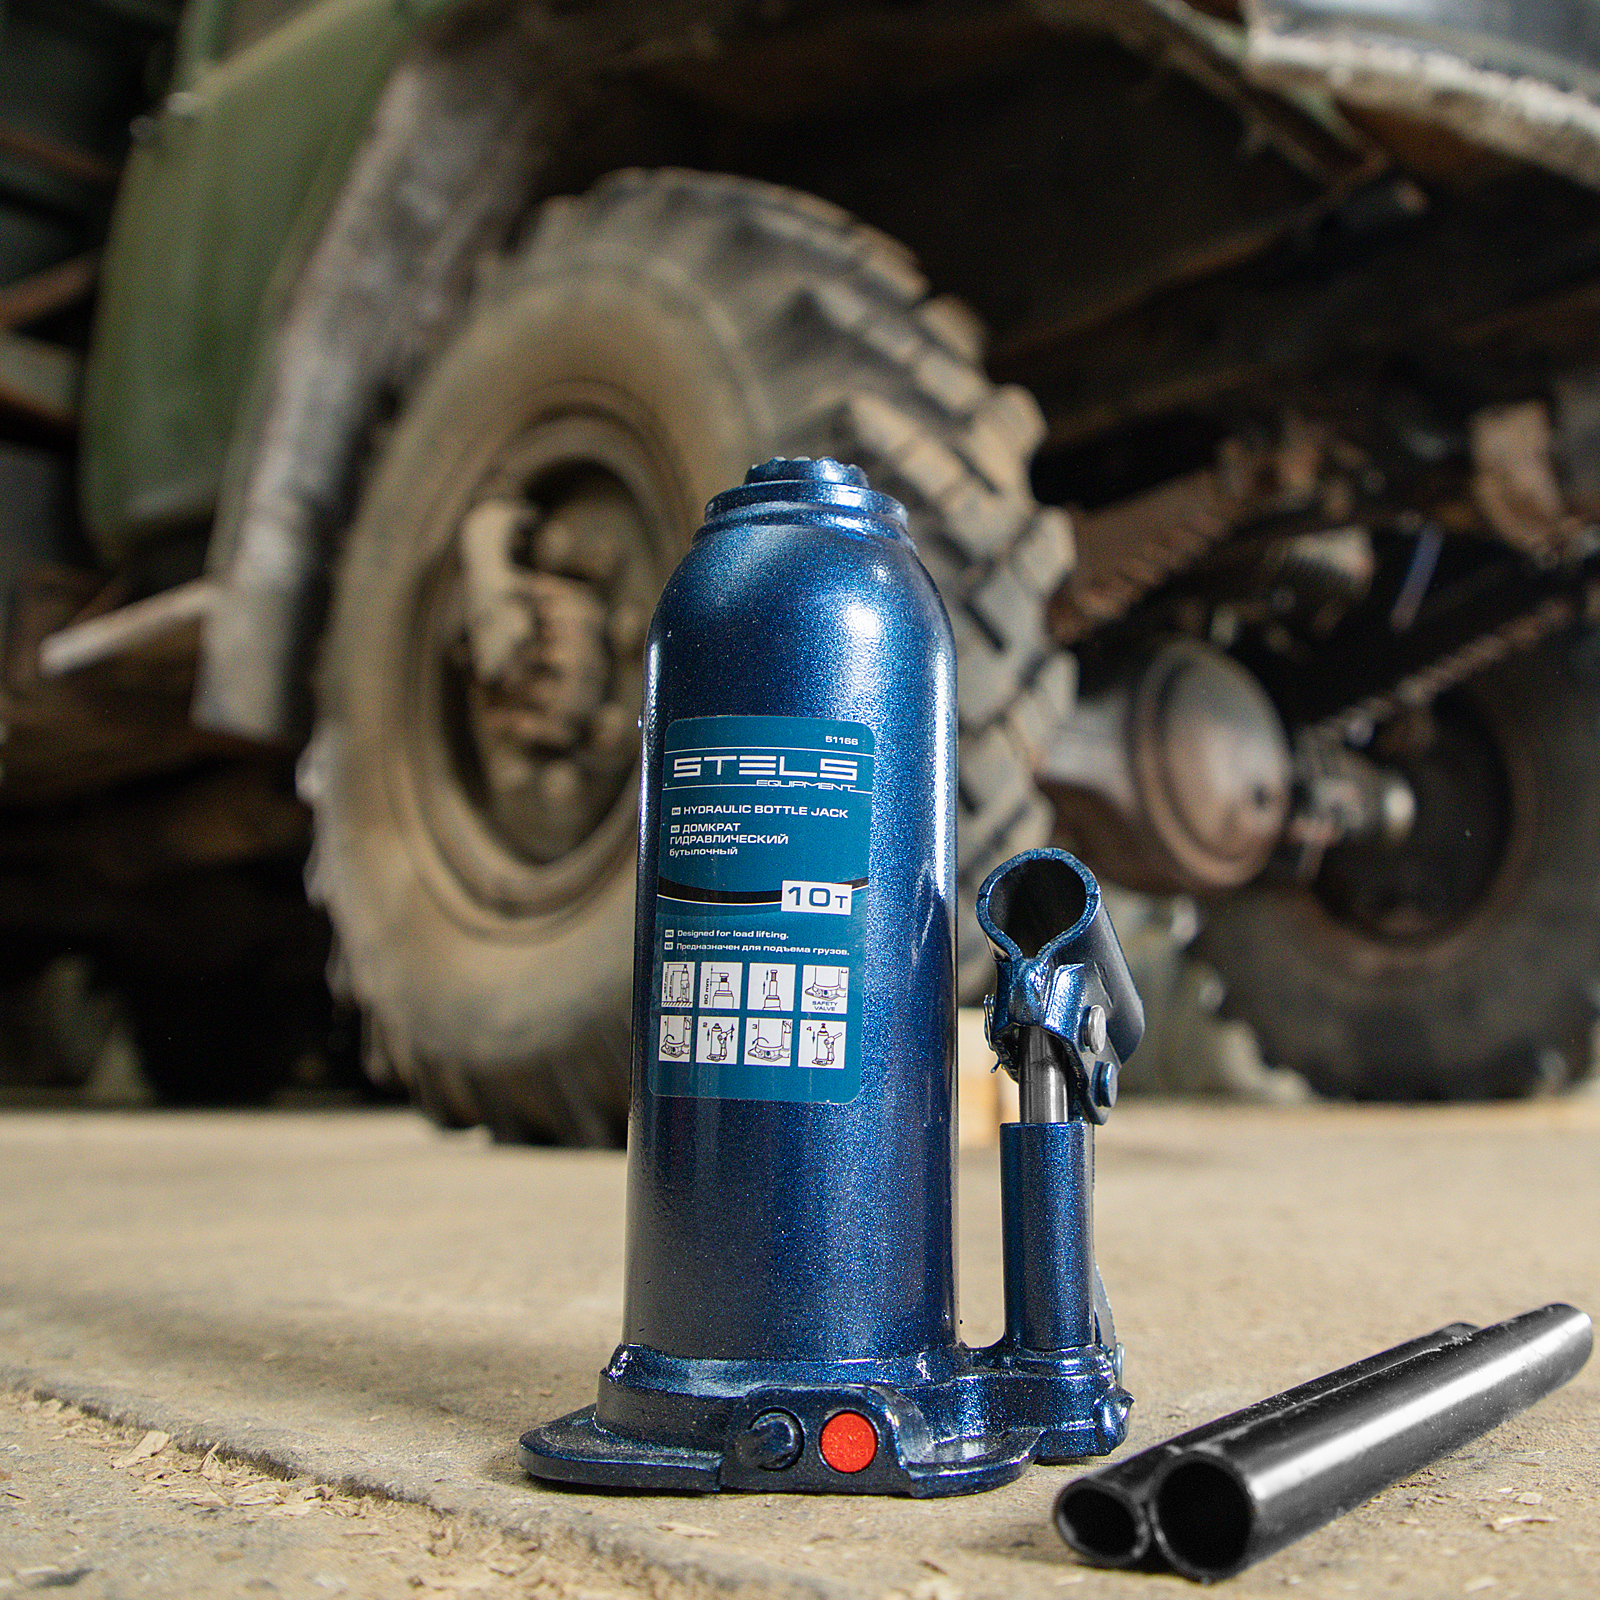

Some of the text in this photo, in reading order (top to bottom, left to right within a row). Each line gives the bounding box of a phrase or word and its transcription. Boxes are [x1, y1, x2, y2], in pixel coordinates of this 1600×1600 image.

[673, 755, 858, 781] STELS
[756, 779, 856, 791] EQUIPMENT
[683, 804, 752, 815] HYDRAULIC
[754, 805, 808, 816] BOTTLE
[810, 807, 849, 819] JACK
[682, 823, 741, 834] ДОМКРАТ
[669, 834, 789, 845] ГИДРАВЛИЧЕСКИЙ
[669, 847, 738, 858] бутылочный
[677, 929, 715, 940] Designed
[716, 929, 731, 938] for
[732, 929, 754, 938] load
[756, 930, 789, 940] lifting.
[676, 942, 740, 952] Предназначен
[741, 944, 761, 952] для
[763, 945, 811, 955] подъема
[812, 947, 850, 957] грузов.
